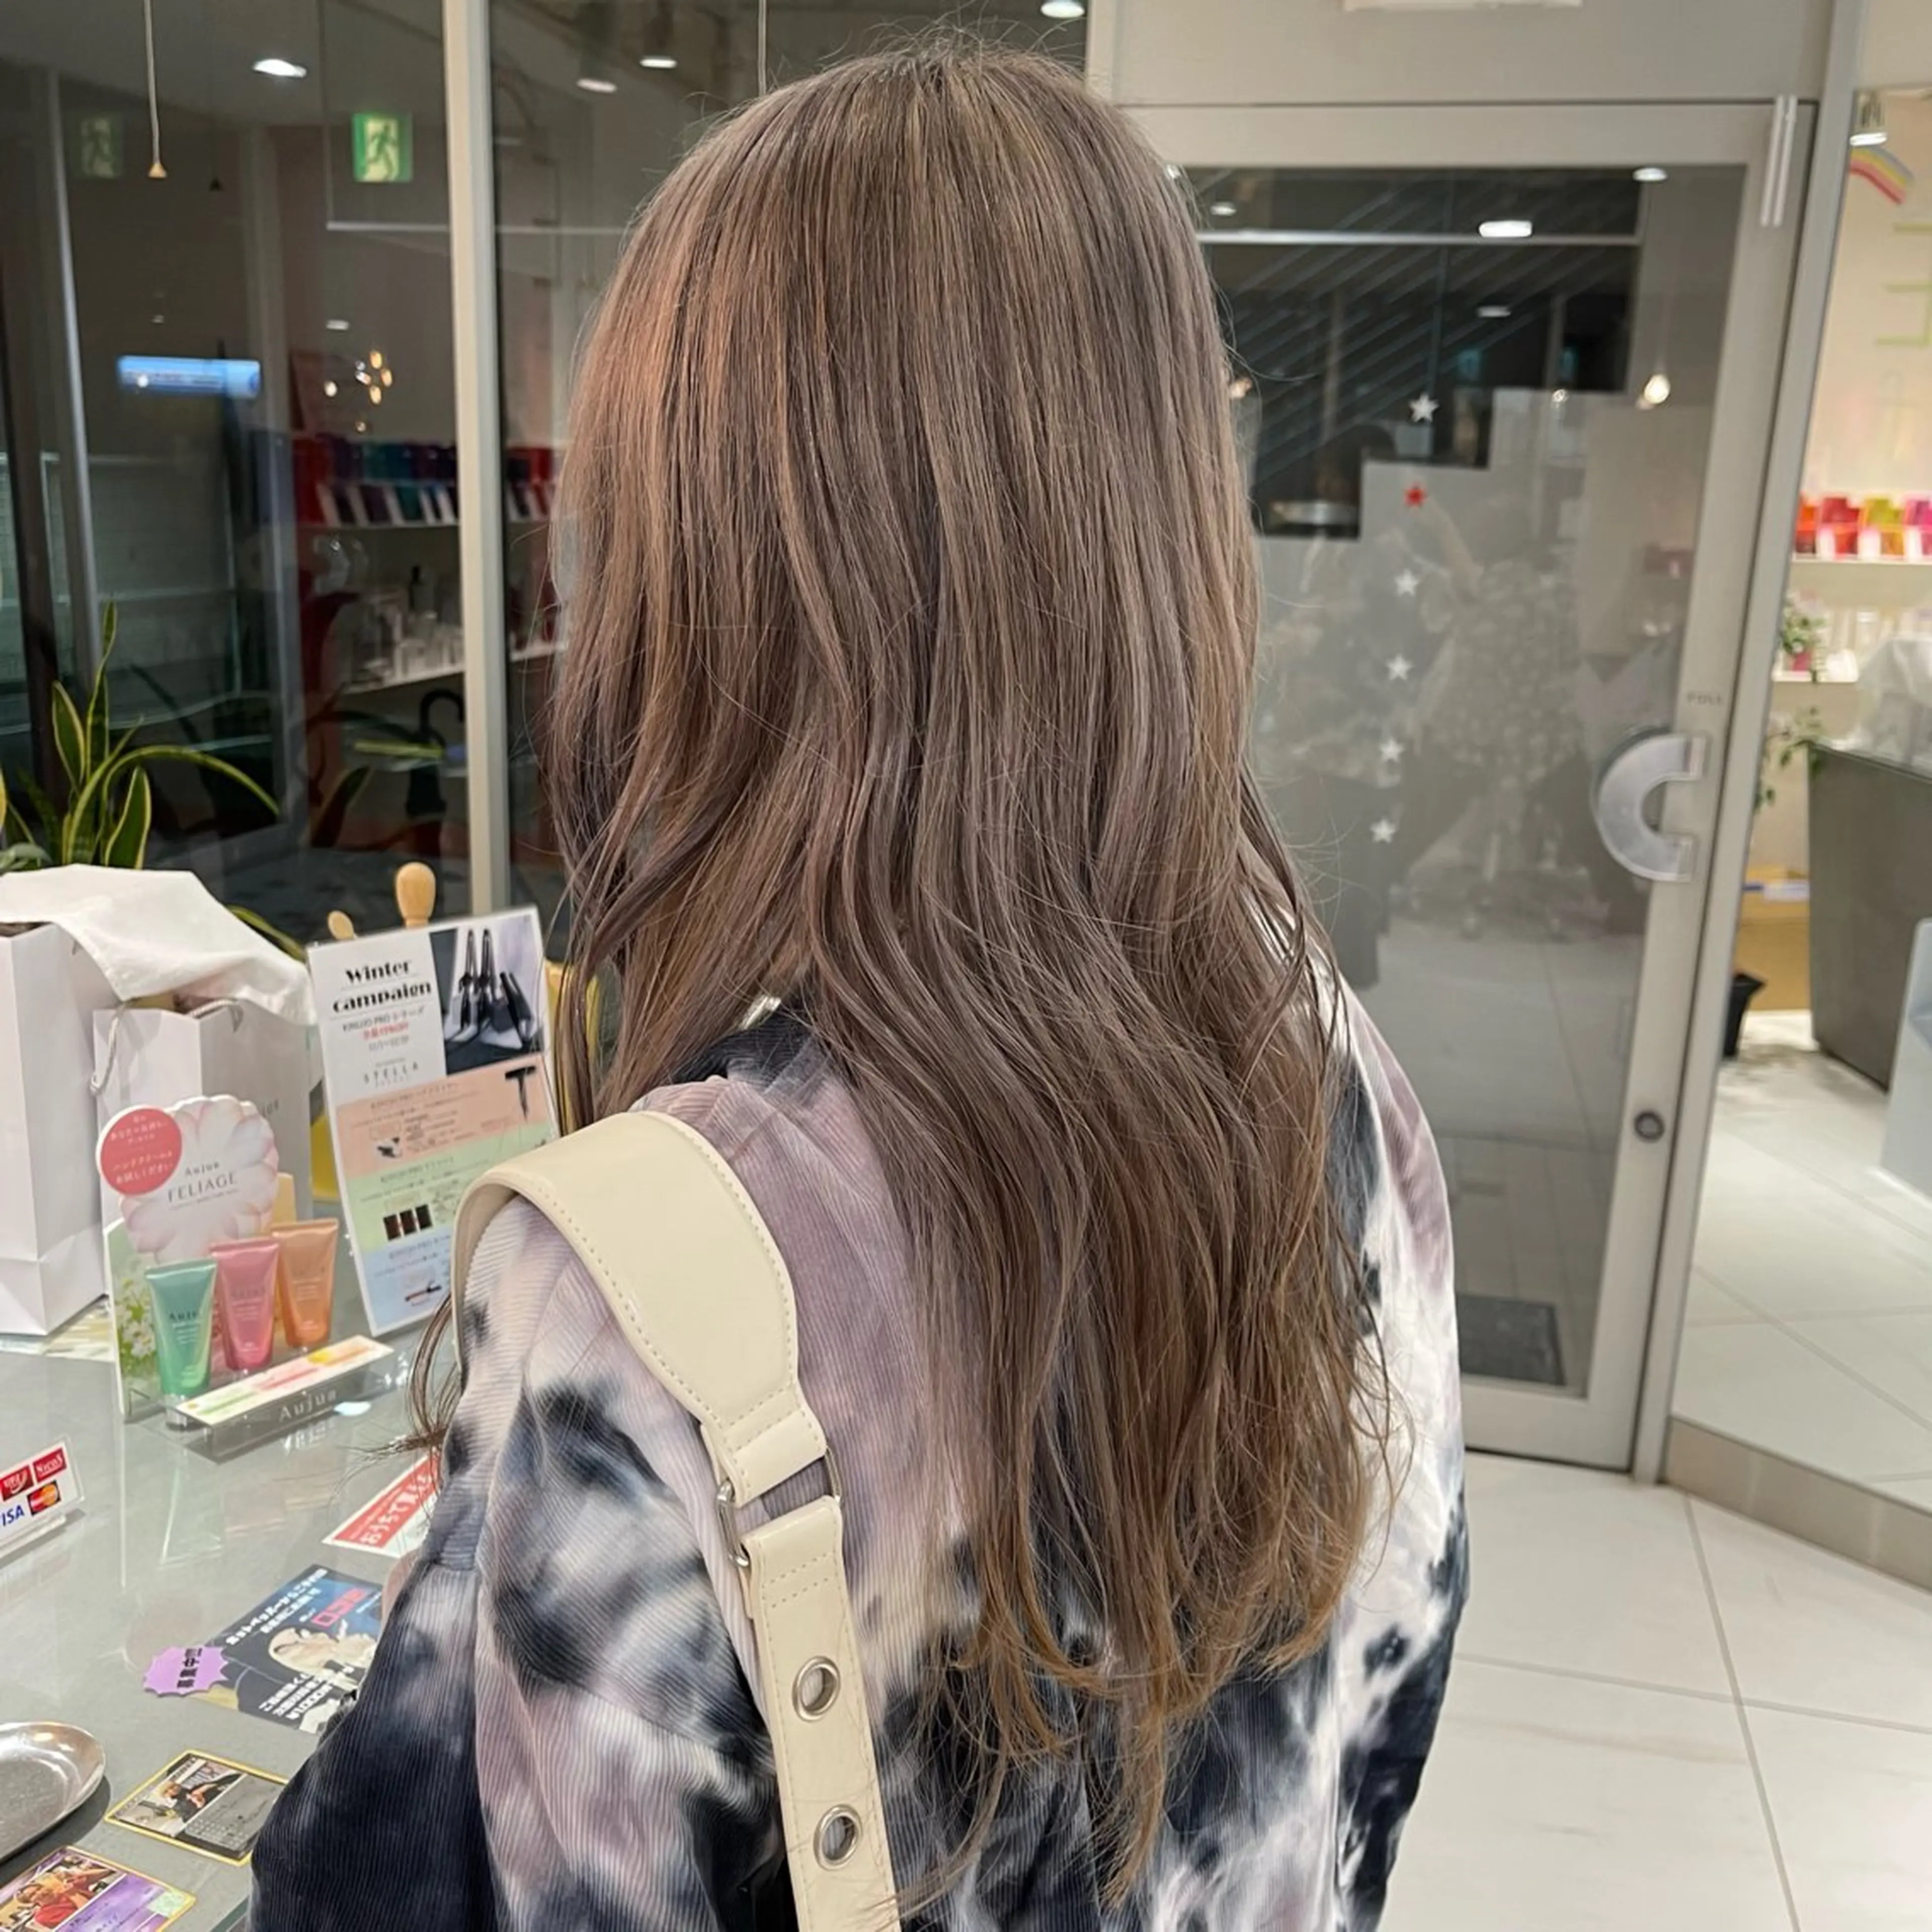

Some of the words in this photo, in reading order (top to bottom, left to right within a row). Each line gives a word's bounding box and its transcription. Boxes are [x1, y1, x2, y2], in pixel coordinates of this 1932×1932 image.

[345, 961, 411, 985] Winter
[168, 1171, 238, 1203] FELIAGE
[279, 1390, 337, 1423] Aujua
[0, 1505, 25, 1527] ISA
